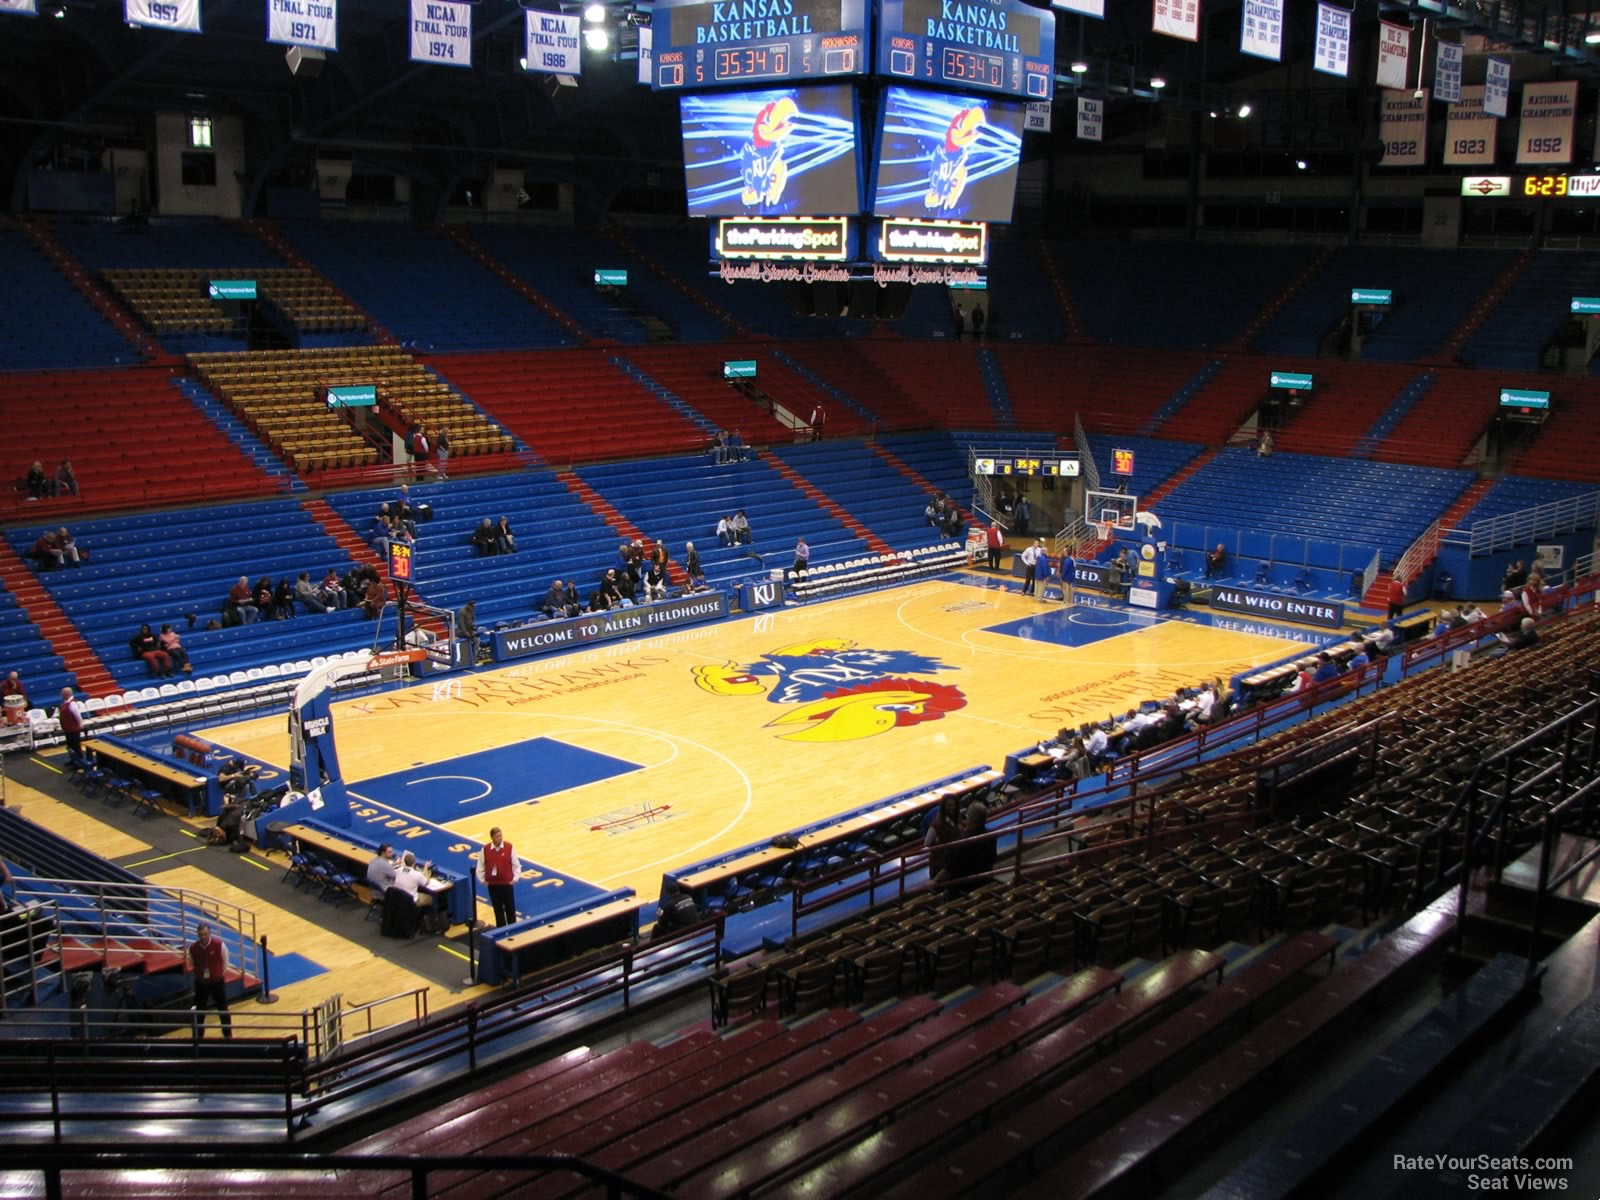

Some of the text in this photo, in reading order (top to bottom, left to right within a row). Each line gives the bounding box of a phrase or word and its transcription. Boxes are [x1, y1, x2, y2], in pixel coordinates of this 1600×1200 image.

[147, 4, 178, 22] 1957
[273, 0, 333, 19] FINAL FOUR
[427, 5, 455, 22] NCAA
[713, 0, 793, 23] KANSAS
[942, 0, 1006, 30] KANSAS
[291, 22, 316, 40] 1971
[415, 21, 468, 38] FINAL FOUR
[541, 18, 567, 34] NCAA
[697, 16, 812, 44] BASKETBALL
[530, 33, 577, 48] FINAL FOUR
[927, 19, 1019, 53] BASKETBALL
[429, 42, 454, 58] 1974
[660, 52, 683, 63] KANSAS
[542, 53, 565, 67] 1986
[775, 55, 784, 73] 0
[843, 51, 852, 71] 0
[905, 55, 913, 73] 0
[673, 66, 682, 84] 0
[991, 67, 998, 84] 0
[1386, 101, 1422, 110] NATIONAL
[1528, 95, 1569, 105] NATIONAL
[1381, 113, 1425, 122] CHAMPIONS
[1522, 108, 1572, 118] CHAMPIONS
[1386, 141, 1417, 155] 1922
[1453, 140, 1486, 154] 1923
[1527, 138, 1562, 153] 1952
[752, 157, 767, 176] KU
[939, 160, 953, 181] KU
[1524, 176, 1568, 196] 6:23
[719, 261, 850, 285] Russell Stover Candies
[873, 263, 909, 288] Russell
[910, 264, 943, 286] Stover
[1004, 465, 1011, 474] 0
[1116, 459, 1130, 473] 30
[392, 545, 410, 558] 35:34
[394, 557, 408, 577] 30
[753, 583, 776, 606] KU
[1217, 591, 1334, 619] ALL WHO ENTER
[506, 600, 721, 652] WELCOME TO ALLEN FIELDHOUSE
[453, 656, 671, 708] JAYHAWKS
[790, 663, 873, 687] KU
[506, 672, 647, 707] Allen Fieldhouse
[304, 716, 329, 730] MUSCLE
